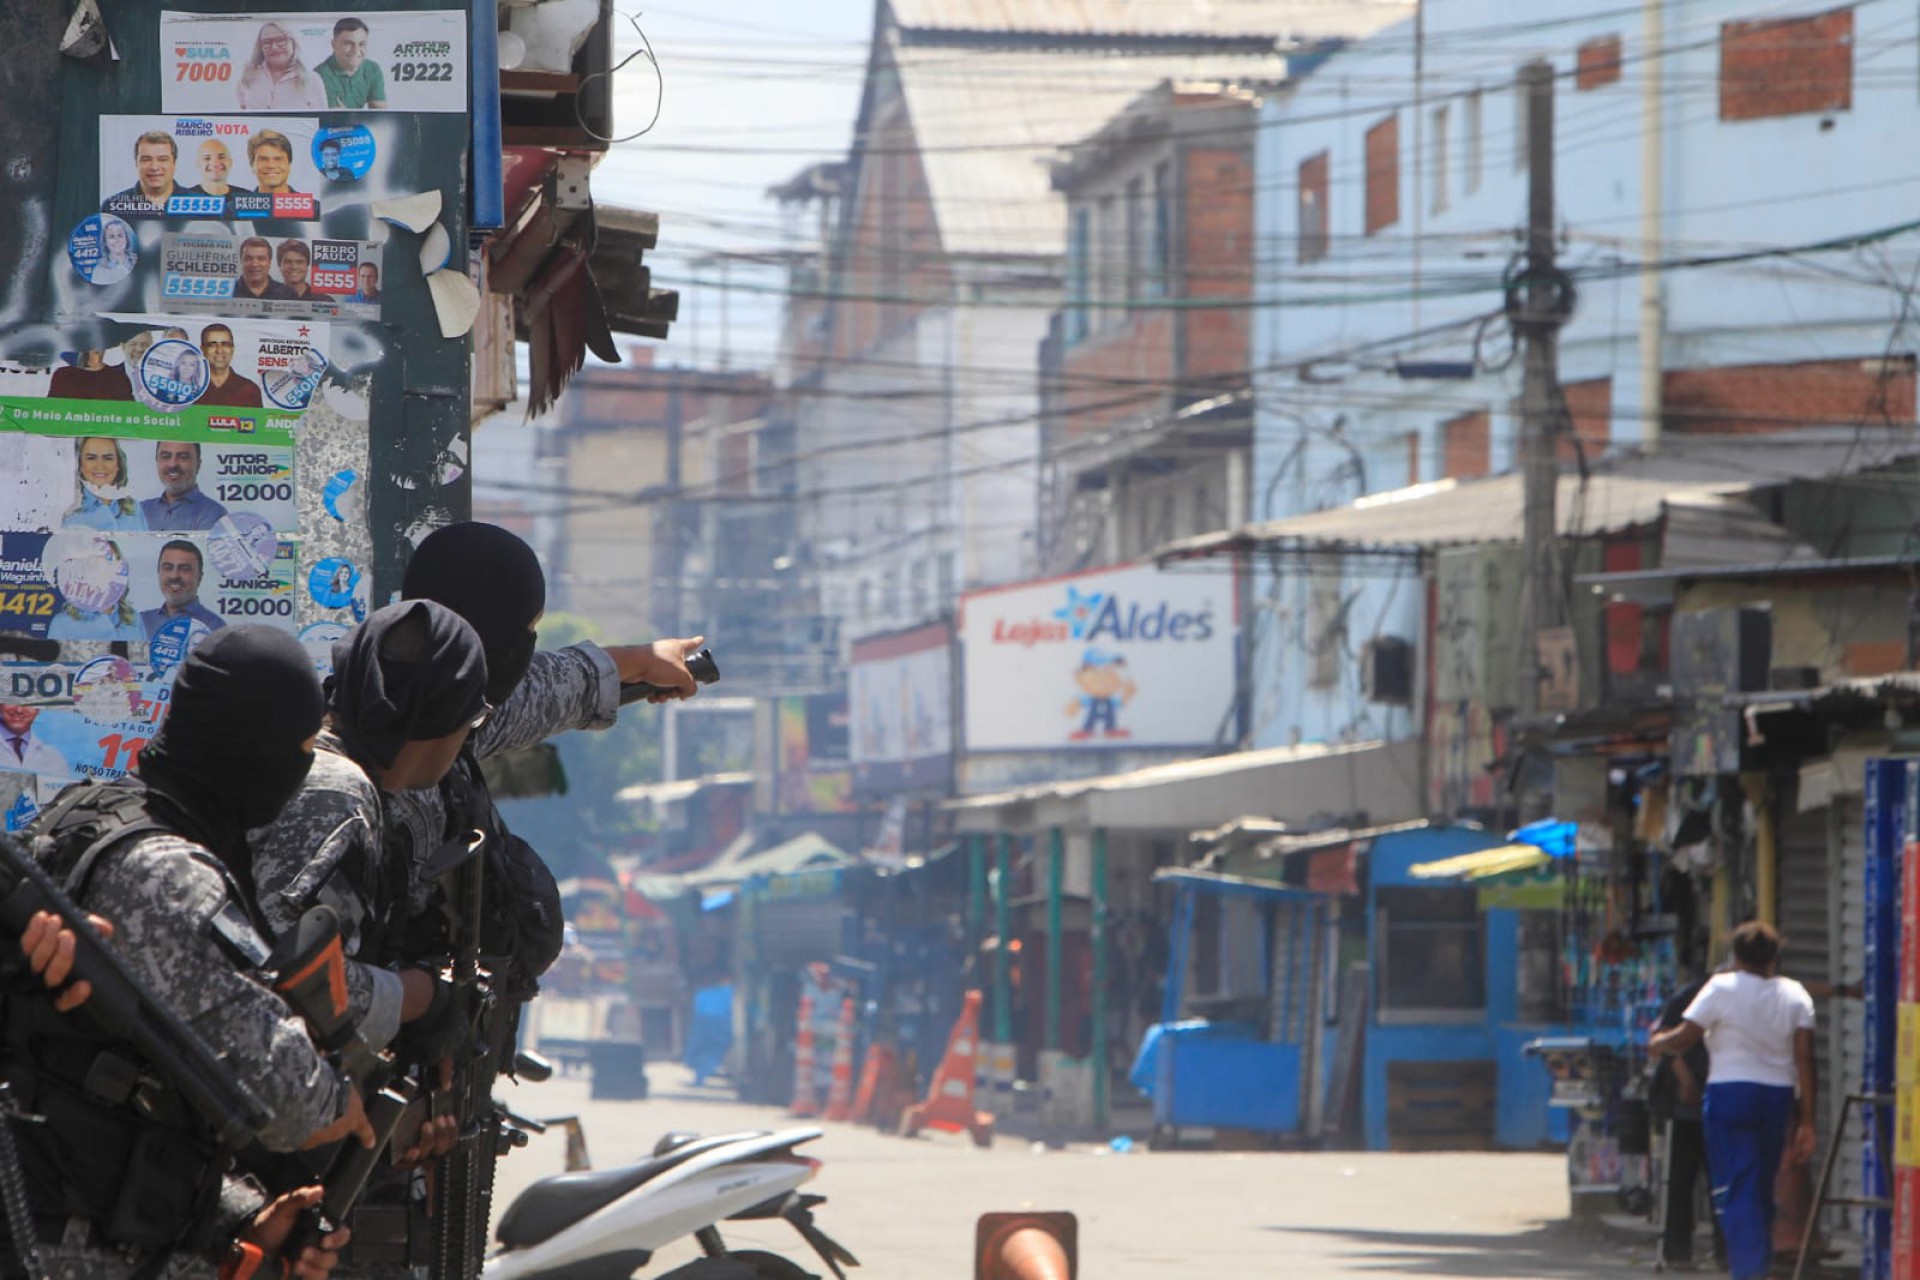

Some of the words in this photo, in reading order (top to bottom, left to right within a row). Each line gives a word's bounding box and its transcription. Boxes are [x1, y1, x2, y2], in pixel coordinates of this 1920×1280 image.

[186, 48, 231, 58] SULA
[393, 42, 450, 54] ARTHUR
[175, 62, 232, 82] 7000
[390, 62, 453, 82] 19222
[215, 124, 249, 135] VOTA
[109, 202, 165, 211] SCHLEDER
[170, 198, 222, 212] 55555
[235, 196, 271, 204] PEDRO
[275, 197, 313, 211] 5555
[314, 245, 356, 254] PEDRO
[167, 250, 238, 264] GUILHERME
[313, 252, 356, 262] PAULO
[166, 261, 238, 274] SCHLEDER
[167, 277, 231, 295] 55555
[313, 272, 355, 289] 5555
[259, 344, 310, 355] ALBERTO
[150, 376, 193, 396] 55010
[287, 372, 320, 405] 55010
[13, 408, 29, 419] Do
[32, 409, 61, 420] Meio
[65, 411, 122, 424] Ambiente
[126, 415, 140, 424] ao
[143, 414, 181, 427] Social
[209, 417, 237, 427] LULA
[240, 420, 253, 431] 13
[216, 454, 268, 465] VITOR
[217, 464, 279, 475] JUNIOR
[216, 483, 292, 502] 12000
[218, 579, 281, 589] JUNIOR
[216, 597, 293, 616] 12000
[992, 615, 1069, 649] Lojas
[1085, 594, 1214, 642] Aldes
